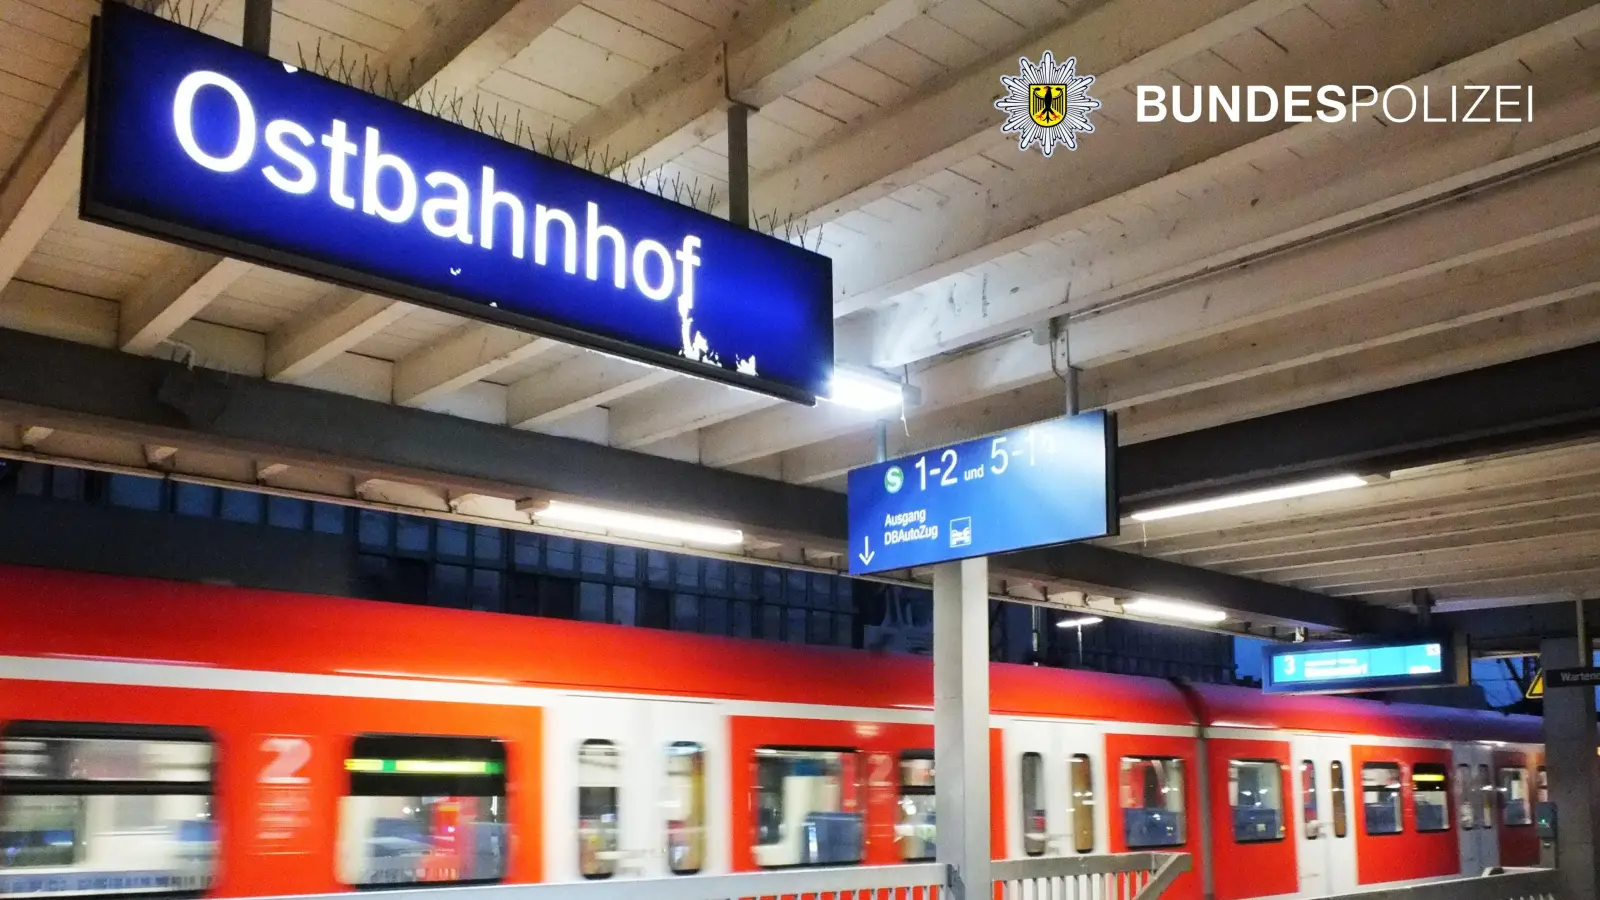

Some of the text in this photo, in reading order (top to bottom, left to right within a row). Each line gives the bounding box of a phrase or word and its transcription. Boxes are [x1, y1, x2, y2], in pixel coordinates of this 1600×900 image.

[173, 69, 701, 304] Ostbahnhof
[885, 467, 902, 491] S
[915, 449, 958, 491] 1-2
[964, 464, 984, 481] und
[885, 509, 926, 527] Ausgang
[884, 525, 938, 546] DBAutoZug
[1283, 655, 1296, 676] 3
[257, 738, 312, 784] 2
[867, 754, 893, 787] 2
